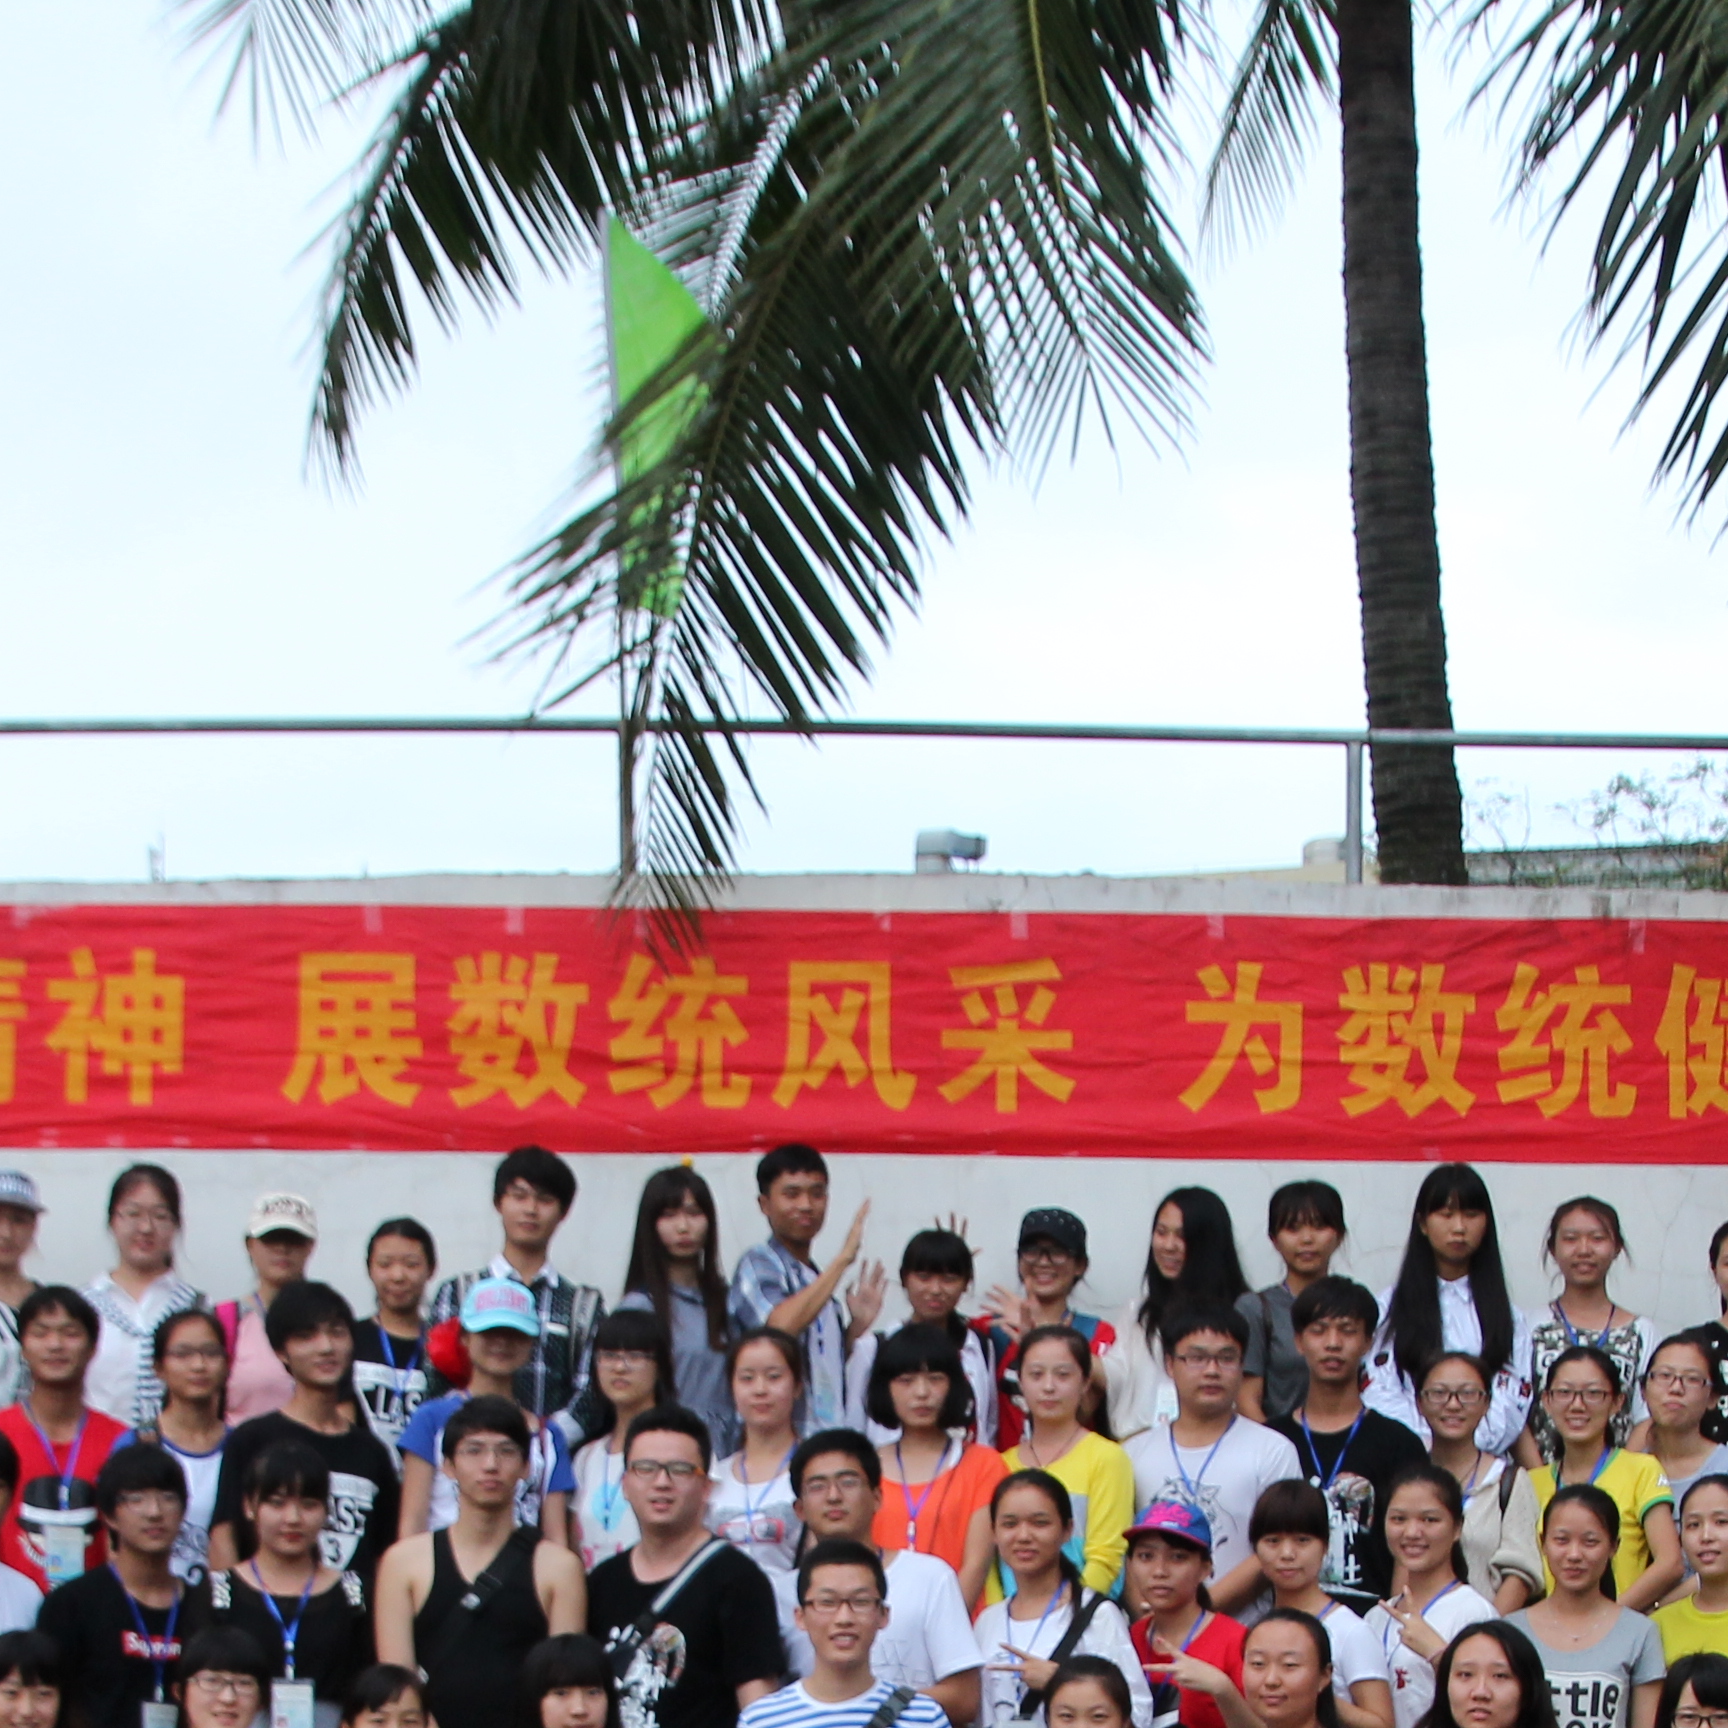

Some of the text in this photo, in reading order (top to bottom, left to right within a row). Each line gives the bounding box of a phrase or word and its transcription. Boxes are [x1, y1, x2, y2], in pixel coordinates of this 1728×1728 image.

[281, 950, 1078, 1112] 展数统风采
